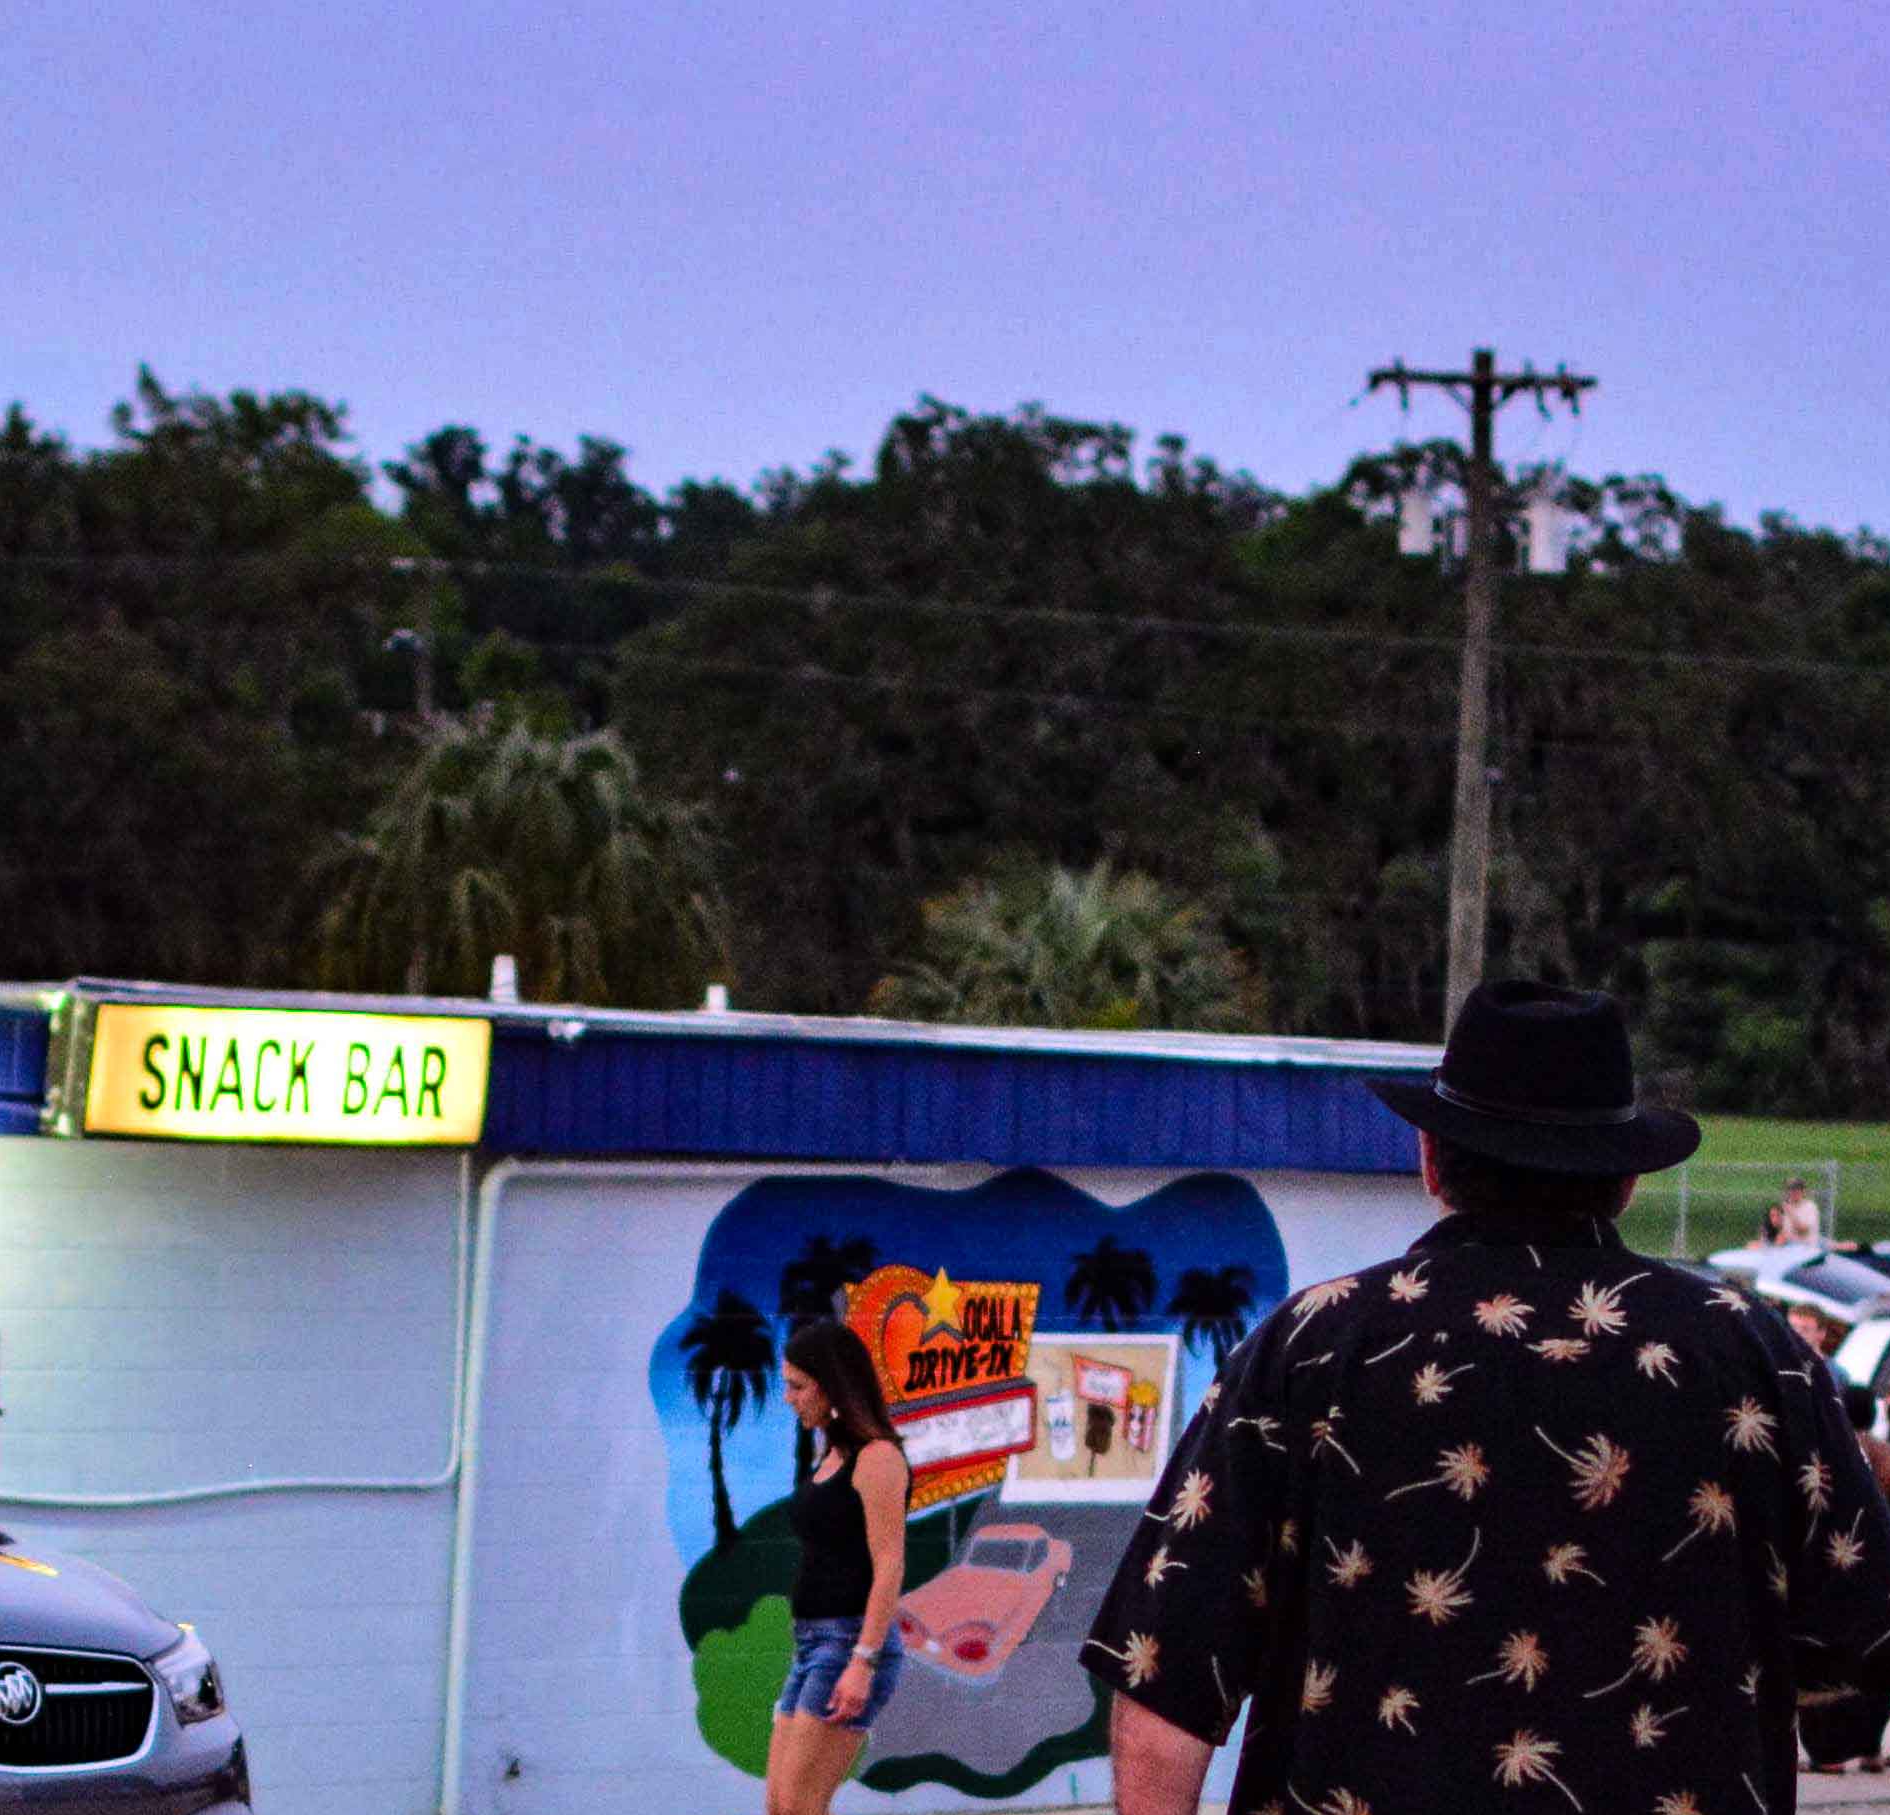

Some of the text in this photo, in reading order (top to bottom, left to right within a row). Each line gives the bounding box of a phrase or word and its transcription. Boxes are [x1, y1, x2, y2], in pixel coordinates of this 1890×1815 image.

[139, 1033, 447, 1118] SNACK BAR
[963, 1296, 1021, 1341] OCALA
